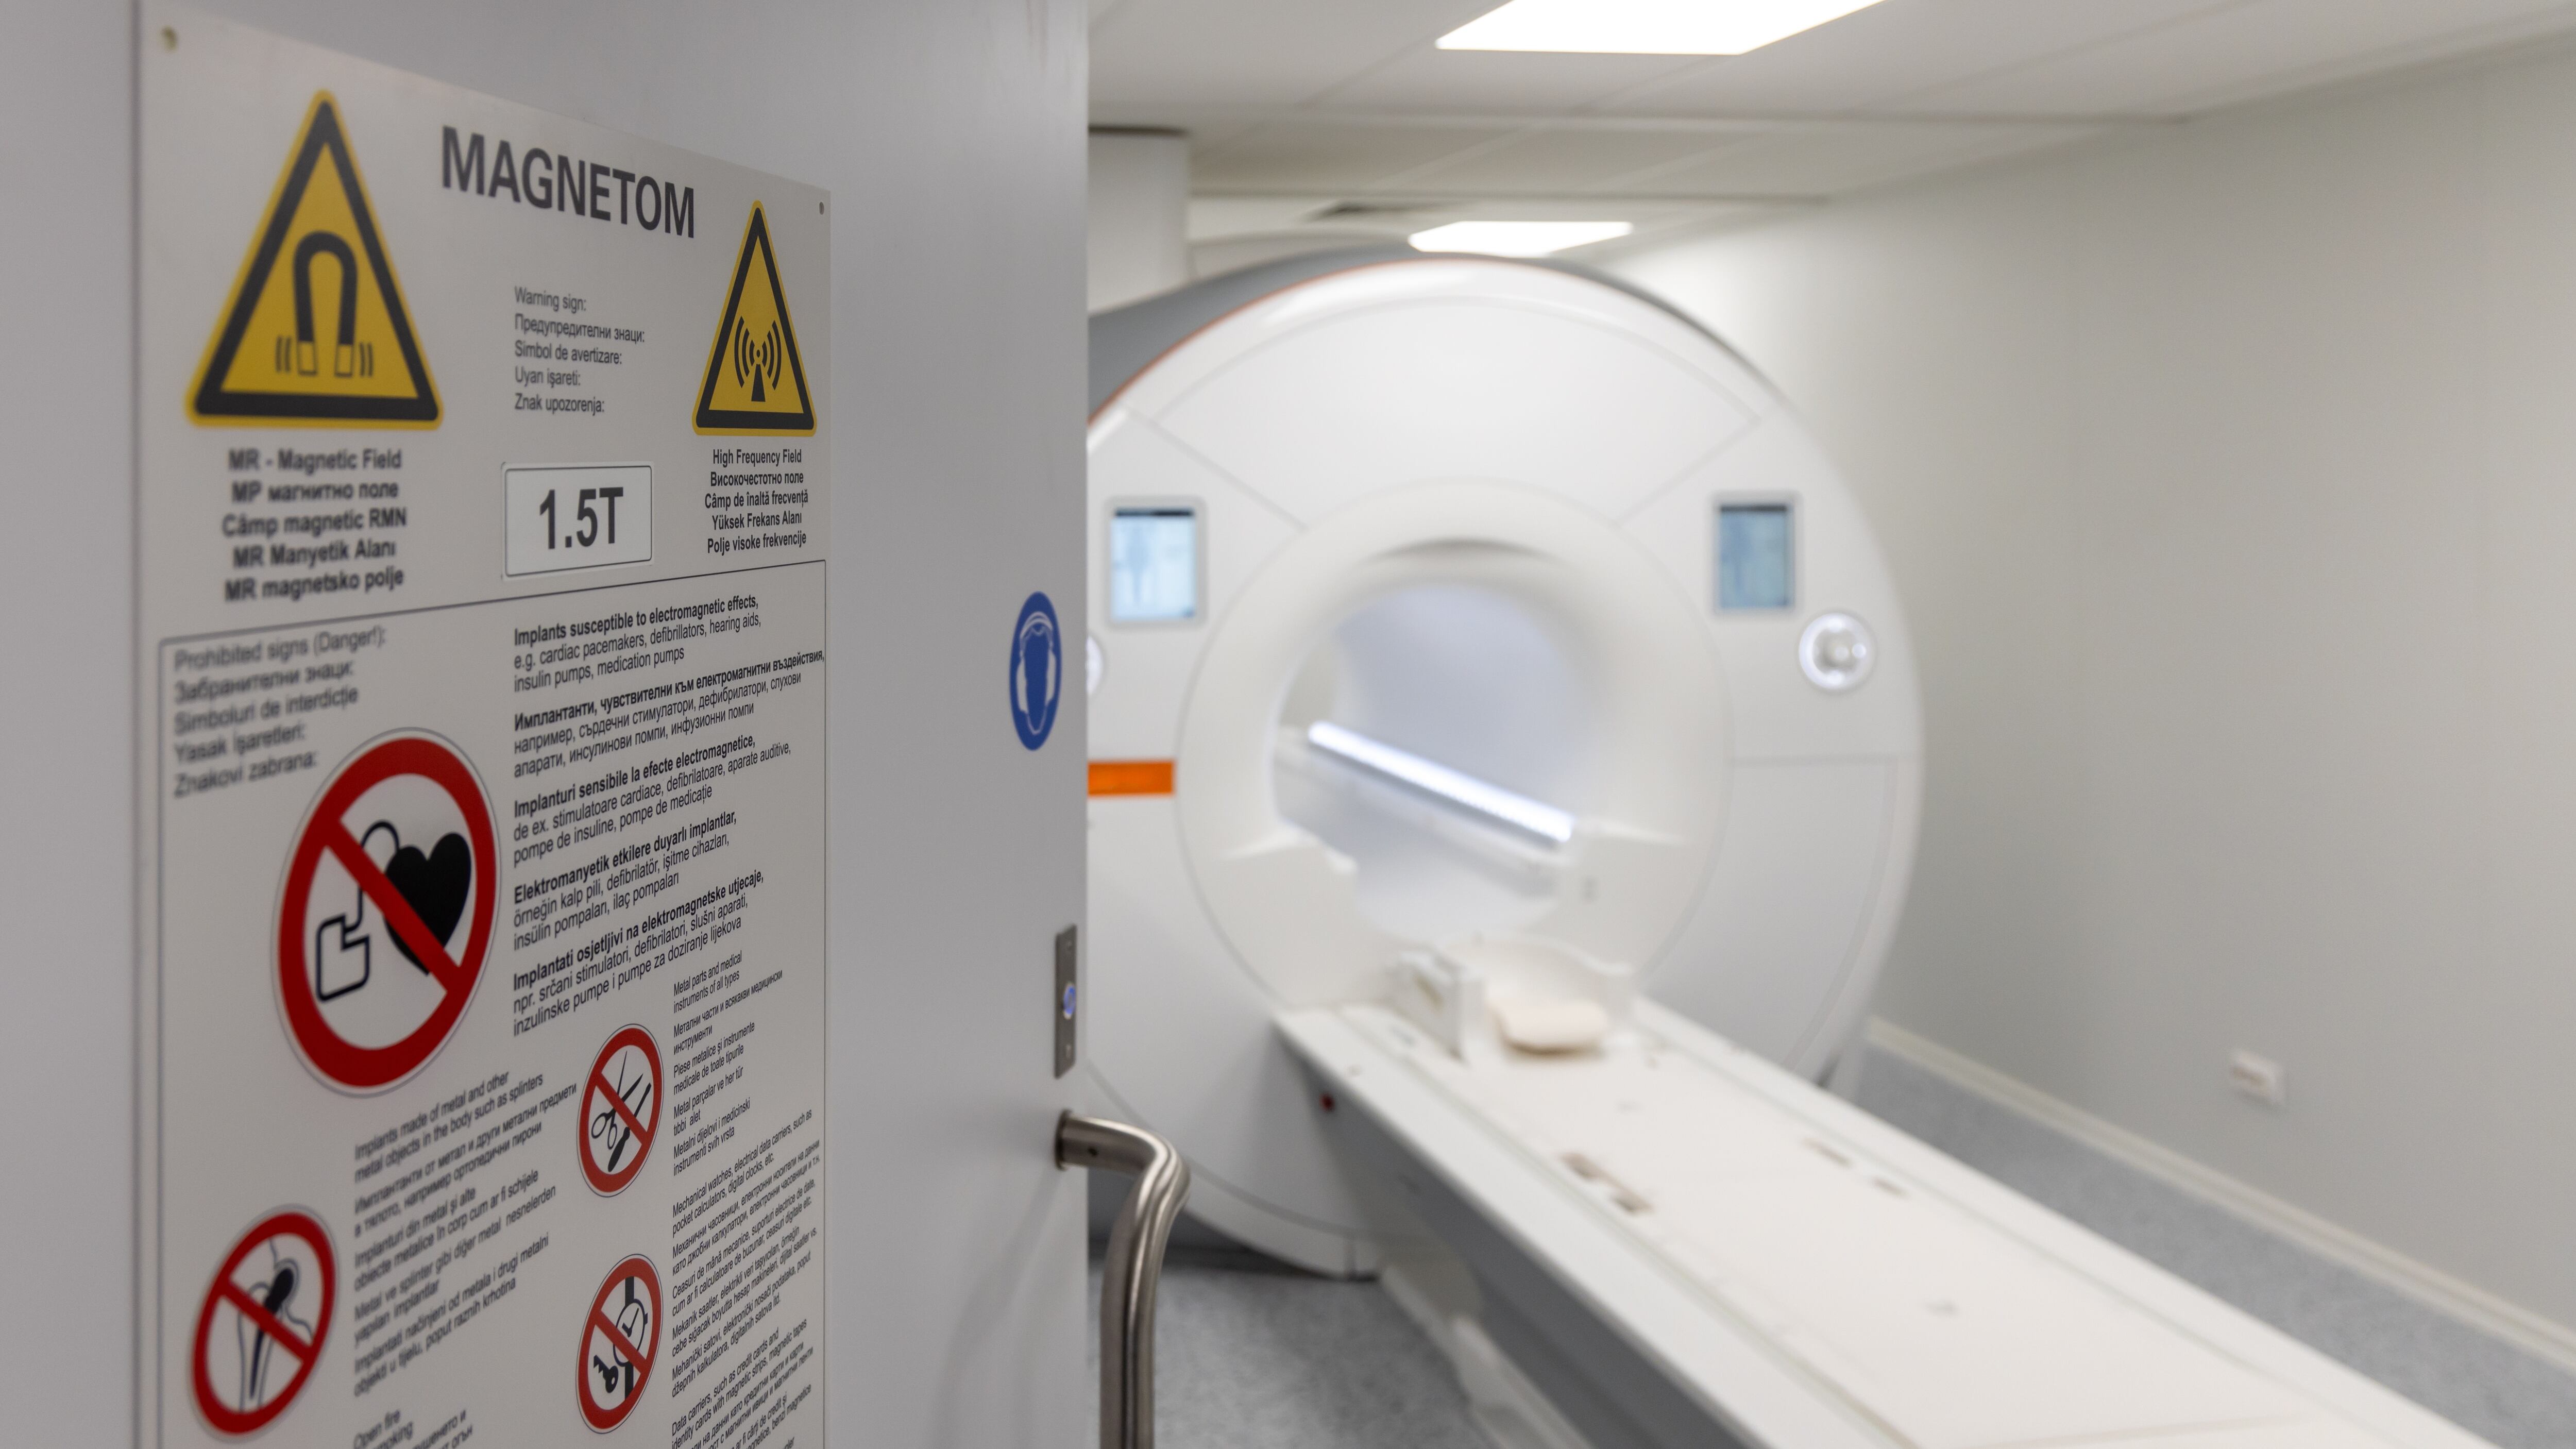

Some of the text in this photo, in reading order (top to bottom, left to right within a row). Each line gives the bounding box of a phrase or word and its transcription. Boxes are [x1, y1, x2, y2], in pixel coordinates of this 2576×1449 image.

[443, 125, 694, 238] MAGNETOM
[515, 286, 586, 314] Warning sign:
[515, 313, 611, 339] Предупредителни
[515, 340, 621, 364] Simbol de avertizare:
[515, 366, 543, 387] Uyan
[515, 393, 604, 416] Znak upozorenja:
[713, 449, 801, 468] High Frequency Field
[785, 473, 803, 483] поле
[539, 486, 623, 549] 1.5T
[705, 493, 731, 511] Câmp
[734, 492, 744, 507] de
[712, 514, 744, 530] Yüksek
[748, 512, 780, 527] Frekans
[708, 530, 806, 556] Polje visoke frekvencije
[515, 595, 758, 647] Implants susceptible to electromagnetic effects,
[540, 644, 580, 664] cardiac
[583, 634, 647, 661] pacemakers,
[650, 619, 706, 644] defibrillators,
[710, 616, 740, 634] hearing
[743, 612, 760, 628] aids,
[515, 648, 684, 692] insulin pumps, medication pumps
[515, 650, 824, 731] Имплантанти, чувствителни към електромагнитни въздействия,
[515, 673, 801, 754] например, сърдечни стимулатори, дефибрилатори, слухови
[514, 703, 753, 778] апарати, инсулинови помпи, инфузионни помпи
[515, 735, 755, 818] Implanturi sensibile la efecte electromagnetice,
[515, 855, 609, 904] Elektromanyetik
[613, 843, 651, 867] etkilere
[690, 812, 736, 838] implantlar,
[514, 870, 763, 991] Implantati osjetljivi na elektromagnetske utjecaje,
[514, 920, 550, 951] insülin
[674, 950, 741, 996] Metal parts and medical
[674, 986, 708, 1013] instruments
[725, 971, 739, 988] types
[674, 1060, 690, 1078] Piese
[692, 1046, 716, 1067] metalice
[724, 1022, 754, 1048] instrumente
[674, 1097, 690, 1119] Metal
[674, 1133, 696, 1159] Metalni
[697, 1119, 717, 1143] dijelovi
[722, 1097, 750, 1126] medicinski
[673, 1182, 706, 1218] Mechanical
[708, 1168, 733, 1191] watches,
[735, 1145, 758, 1172] electrical
[759, 1139, 771, 1154] data
[672, 1416, 686, 1436] Data
[714, 1376, 727, 1397] such
[737, 1353, 752, 1375] credit
[753, 1340, 768, 1360] cards
